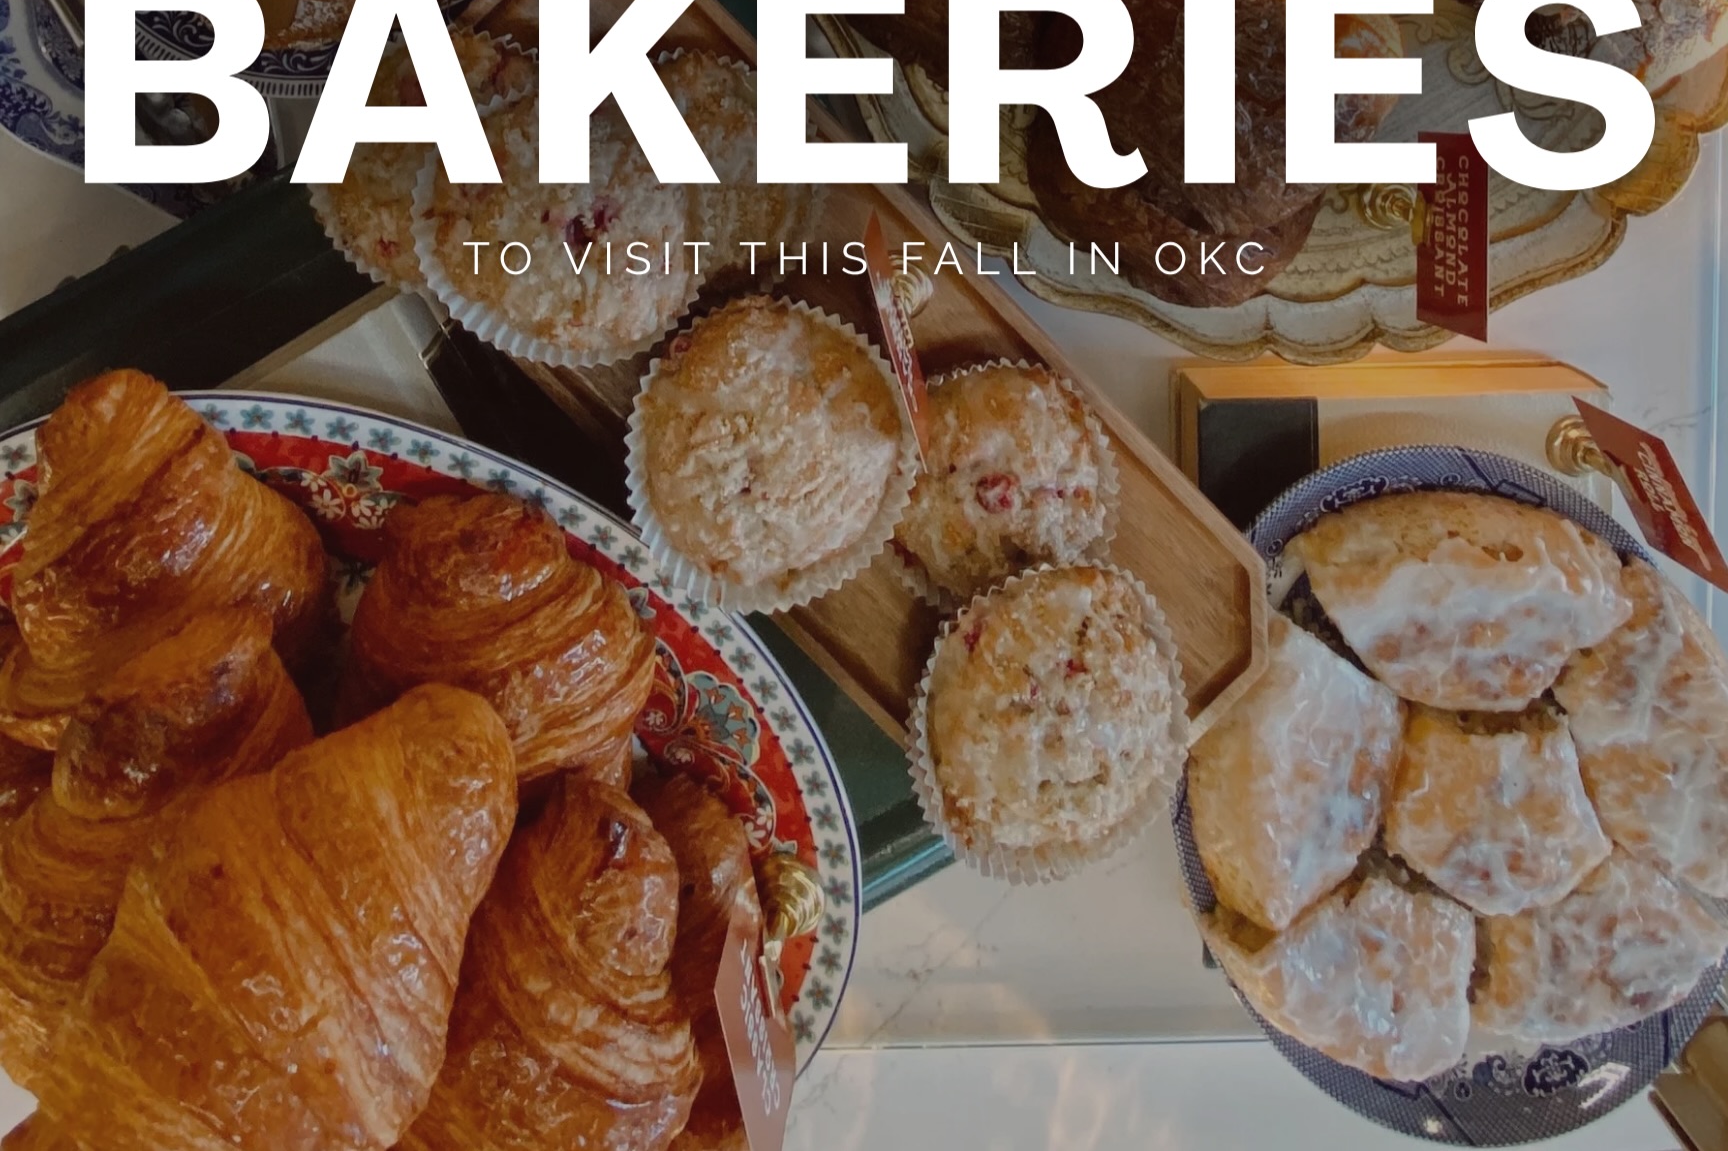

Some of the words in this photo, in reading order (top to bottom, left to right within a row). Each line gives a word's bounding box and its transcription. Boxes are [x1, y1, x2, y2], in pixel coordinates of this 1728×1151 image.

[1434, 156, 1446, 298] CROISSANT
[1443, 172, 1457, 286] ALMOND
[1457, 155, 1470, 307] CHOCOLATE
